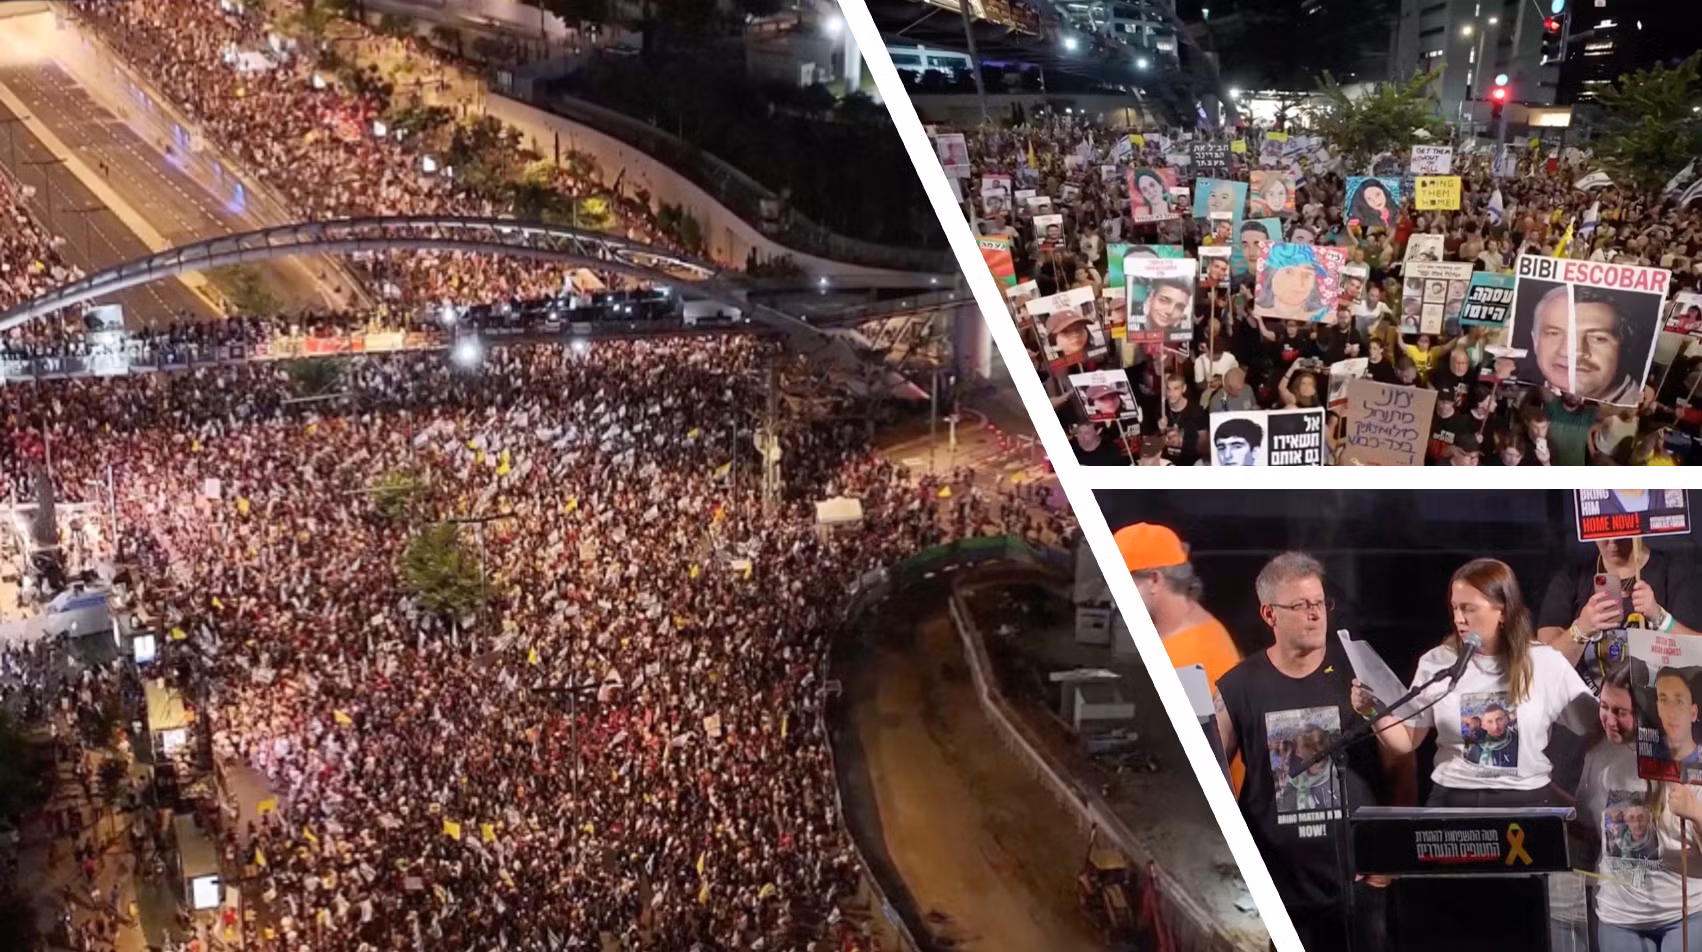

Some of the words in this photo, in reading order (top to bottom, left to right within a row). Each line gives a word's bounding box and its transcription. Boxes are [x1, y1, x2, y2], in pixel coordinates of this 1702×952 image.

[1422, 190, 1450, 198] THEM
[1519, 256, 1558, 279] BIBI
[1563, 262, 1667, 292] ESCOBAR
[1374, 388, 1414, 408] ימני
[1363, 400, 1415, 423] מתנחל
[1304, 415, 1320, 432] אל
[1273, 433, 1320, 450] תשאירו
[1271, 450, 1302, 465] אותם
[1305, 448, 1320, 463] גם
[1581, 500, 1600, 516] HIM
[1583, 516, 1609, 533] HOME
[1612, 512, 1640, 530] NOW!
[1638, 727, 1660, 743] BRING
[1639, 742, 1653, 757] HIM
[1299, 823, 1327, 838] NOW!
[1415, 830, 1443, 843] להחזרת
[1444, 829, 1480, 842] המשפחות
[1481, 829, 1498, 841] מטה
[1417, 843, 1459, 858] והנעדרים
[1460, 842, 1500, 858] החטופים
